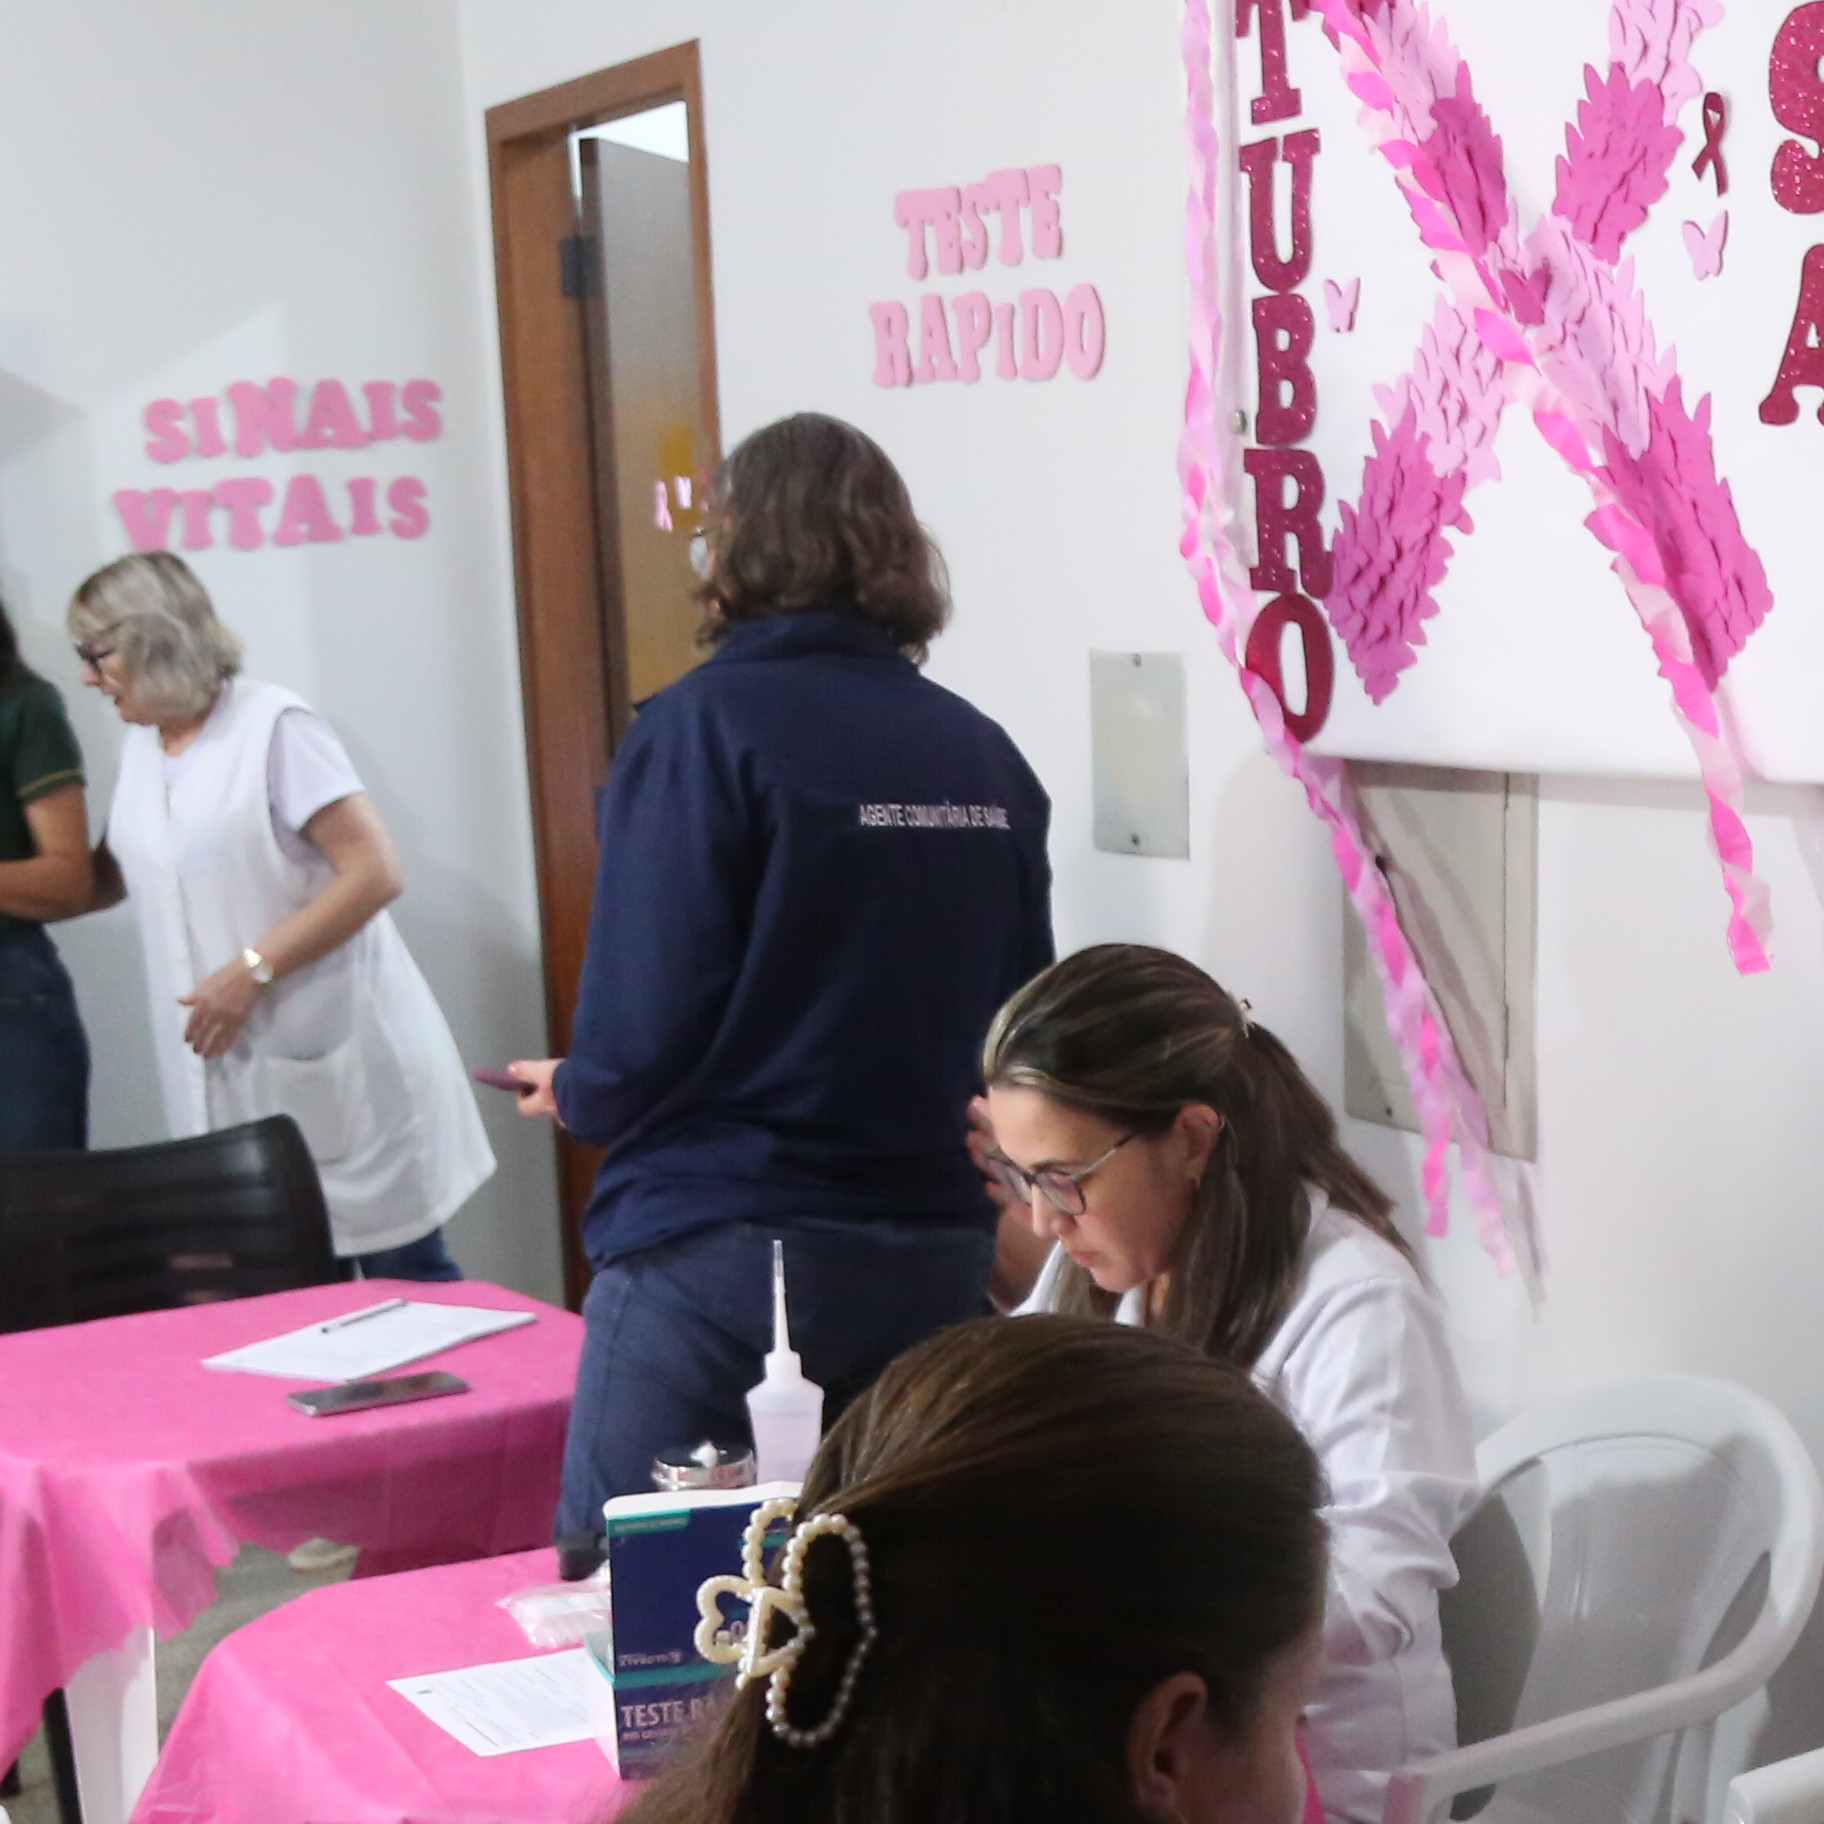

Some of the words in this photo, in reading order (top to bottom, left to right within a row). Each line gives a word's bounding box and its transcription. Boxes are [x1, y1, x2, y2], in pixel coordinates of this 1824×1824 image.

[894, 164, 1063, 281] TESTE
[870, 284, 1106, 388] RAPIDO
[143, 377, 442, 464] SINAIS
[113, 474, 431, 552] VITAIS
[860, 803, 906, 827] AGENTE
